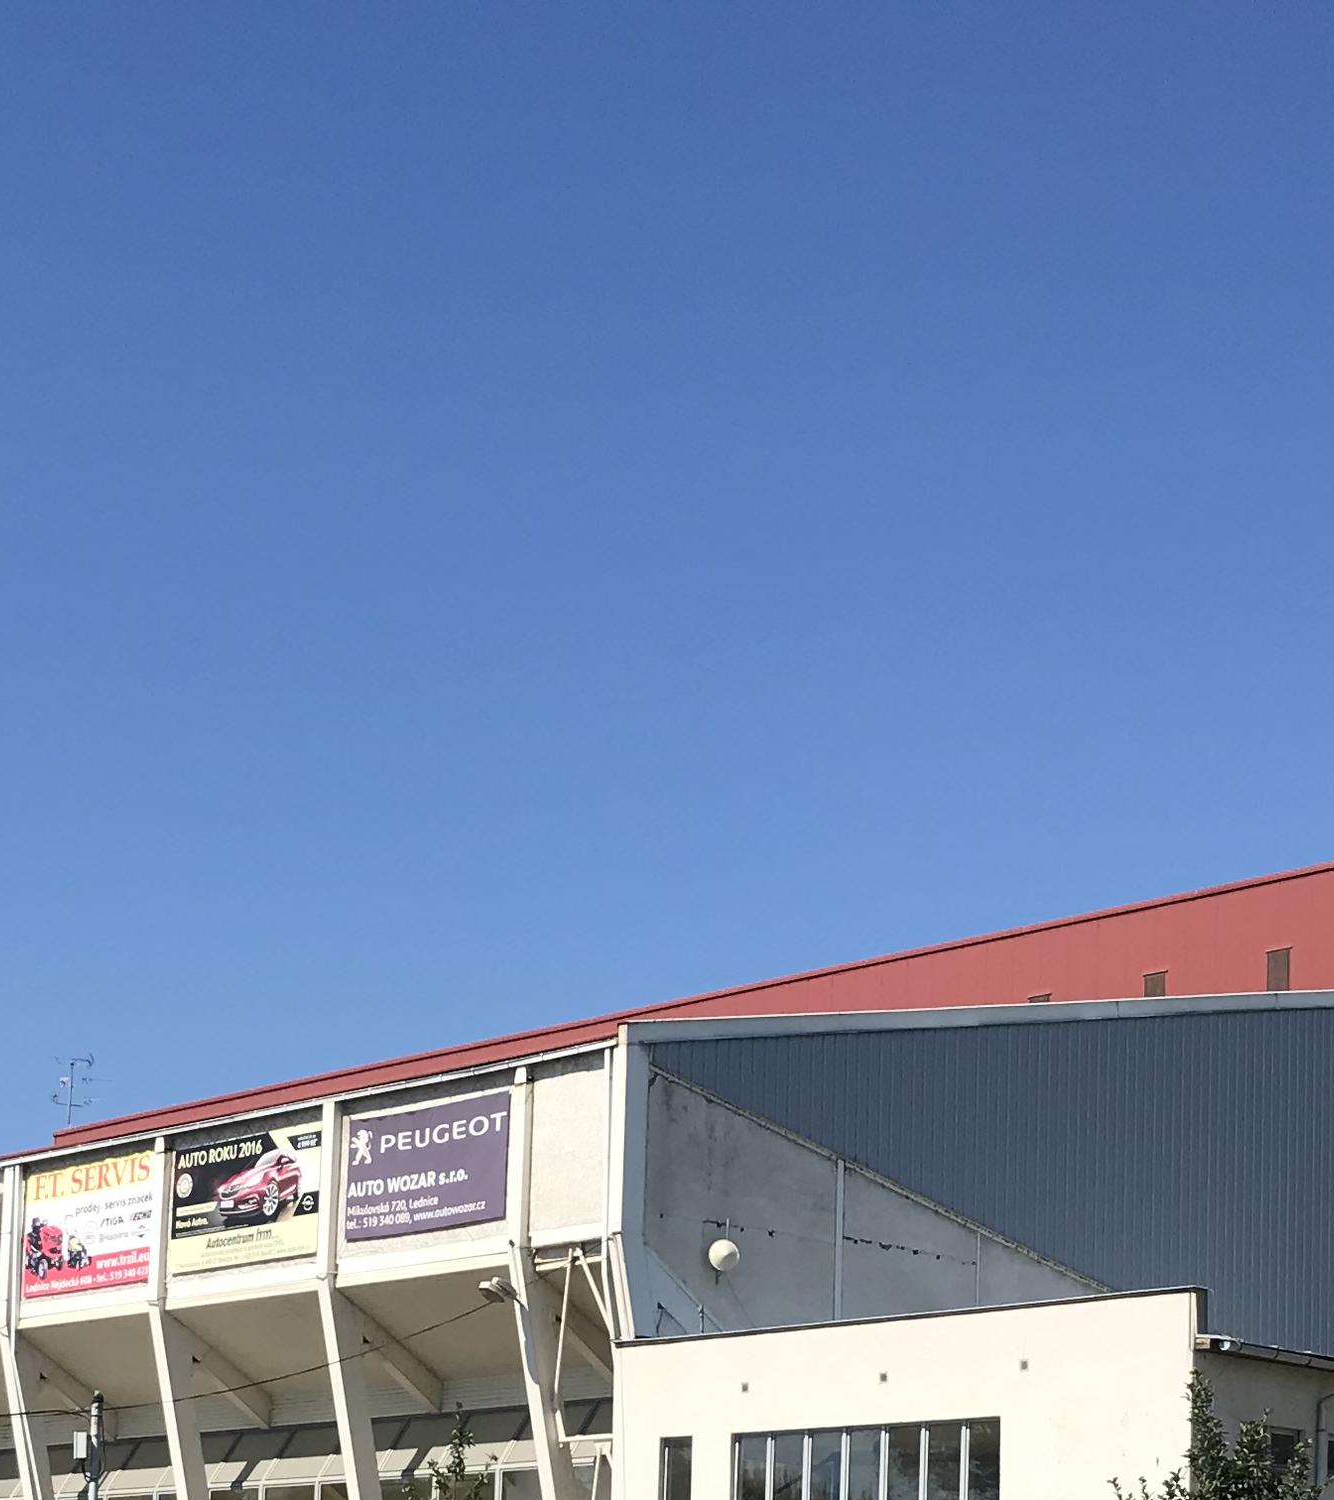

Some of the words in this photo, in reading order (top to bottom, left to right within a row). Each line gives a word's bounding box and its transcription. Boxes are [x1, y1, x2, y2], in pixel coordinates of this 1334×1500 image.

[380, 1111, 507, 1153] PEUGEOT
[178, 1151, 207, 1169] AUTO
[209, 1144, 237, 1163] ROKU
[238, 1139, 262, 1158] 2016
[71, 1155, 151, 1194] SERVIS
[348, 1178, 384, 1198] AUTO
[387, 1170, 436, 1193] WOZAR
[438, 1168, 468, 1186] s.r.o.
[105, 1197, 126, 1210] servis
[363, 1216, 377, 1229] 519
[379, 1214, 393, 1227] 340
[413, 1200, 486, 1221] www.autowozar.cz
[409, 1195, 439, 1209] Lednice
[206, 1231, 254, 1250] Autocentrum
